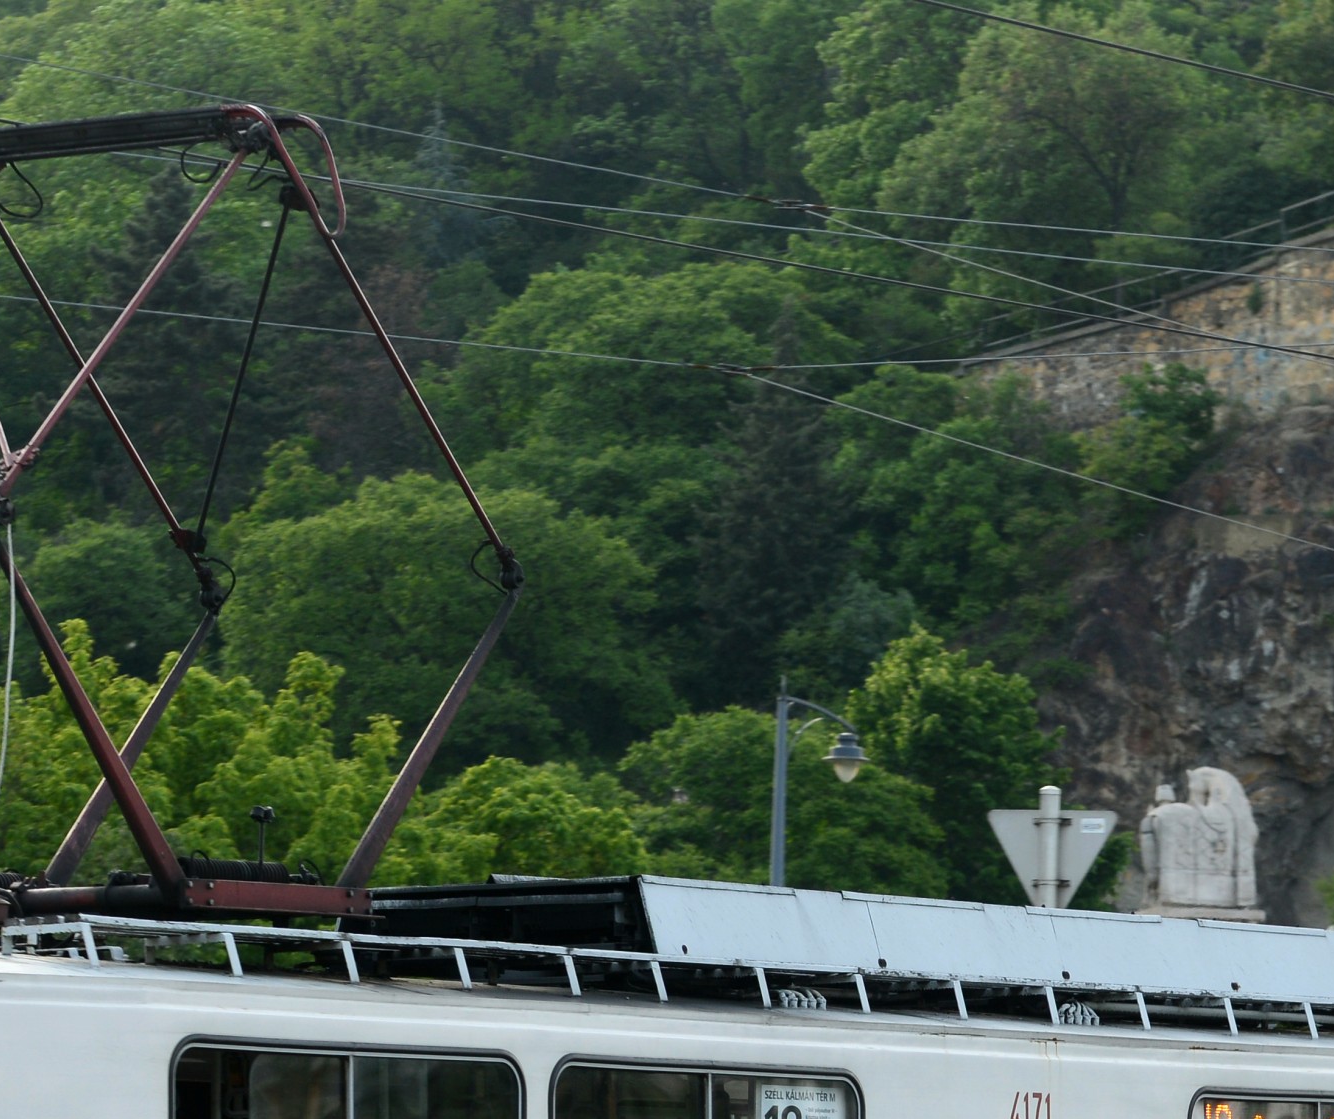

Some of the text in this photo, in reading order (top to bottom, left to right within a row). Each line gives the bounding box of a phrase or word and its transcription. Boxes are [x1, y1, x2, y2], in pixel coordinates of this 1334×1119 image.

[764, 1090, 836, 1102] SZÉLL KÁLMÁN TÉR M
